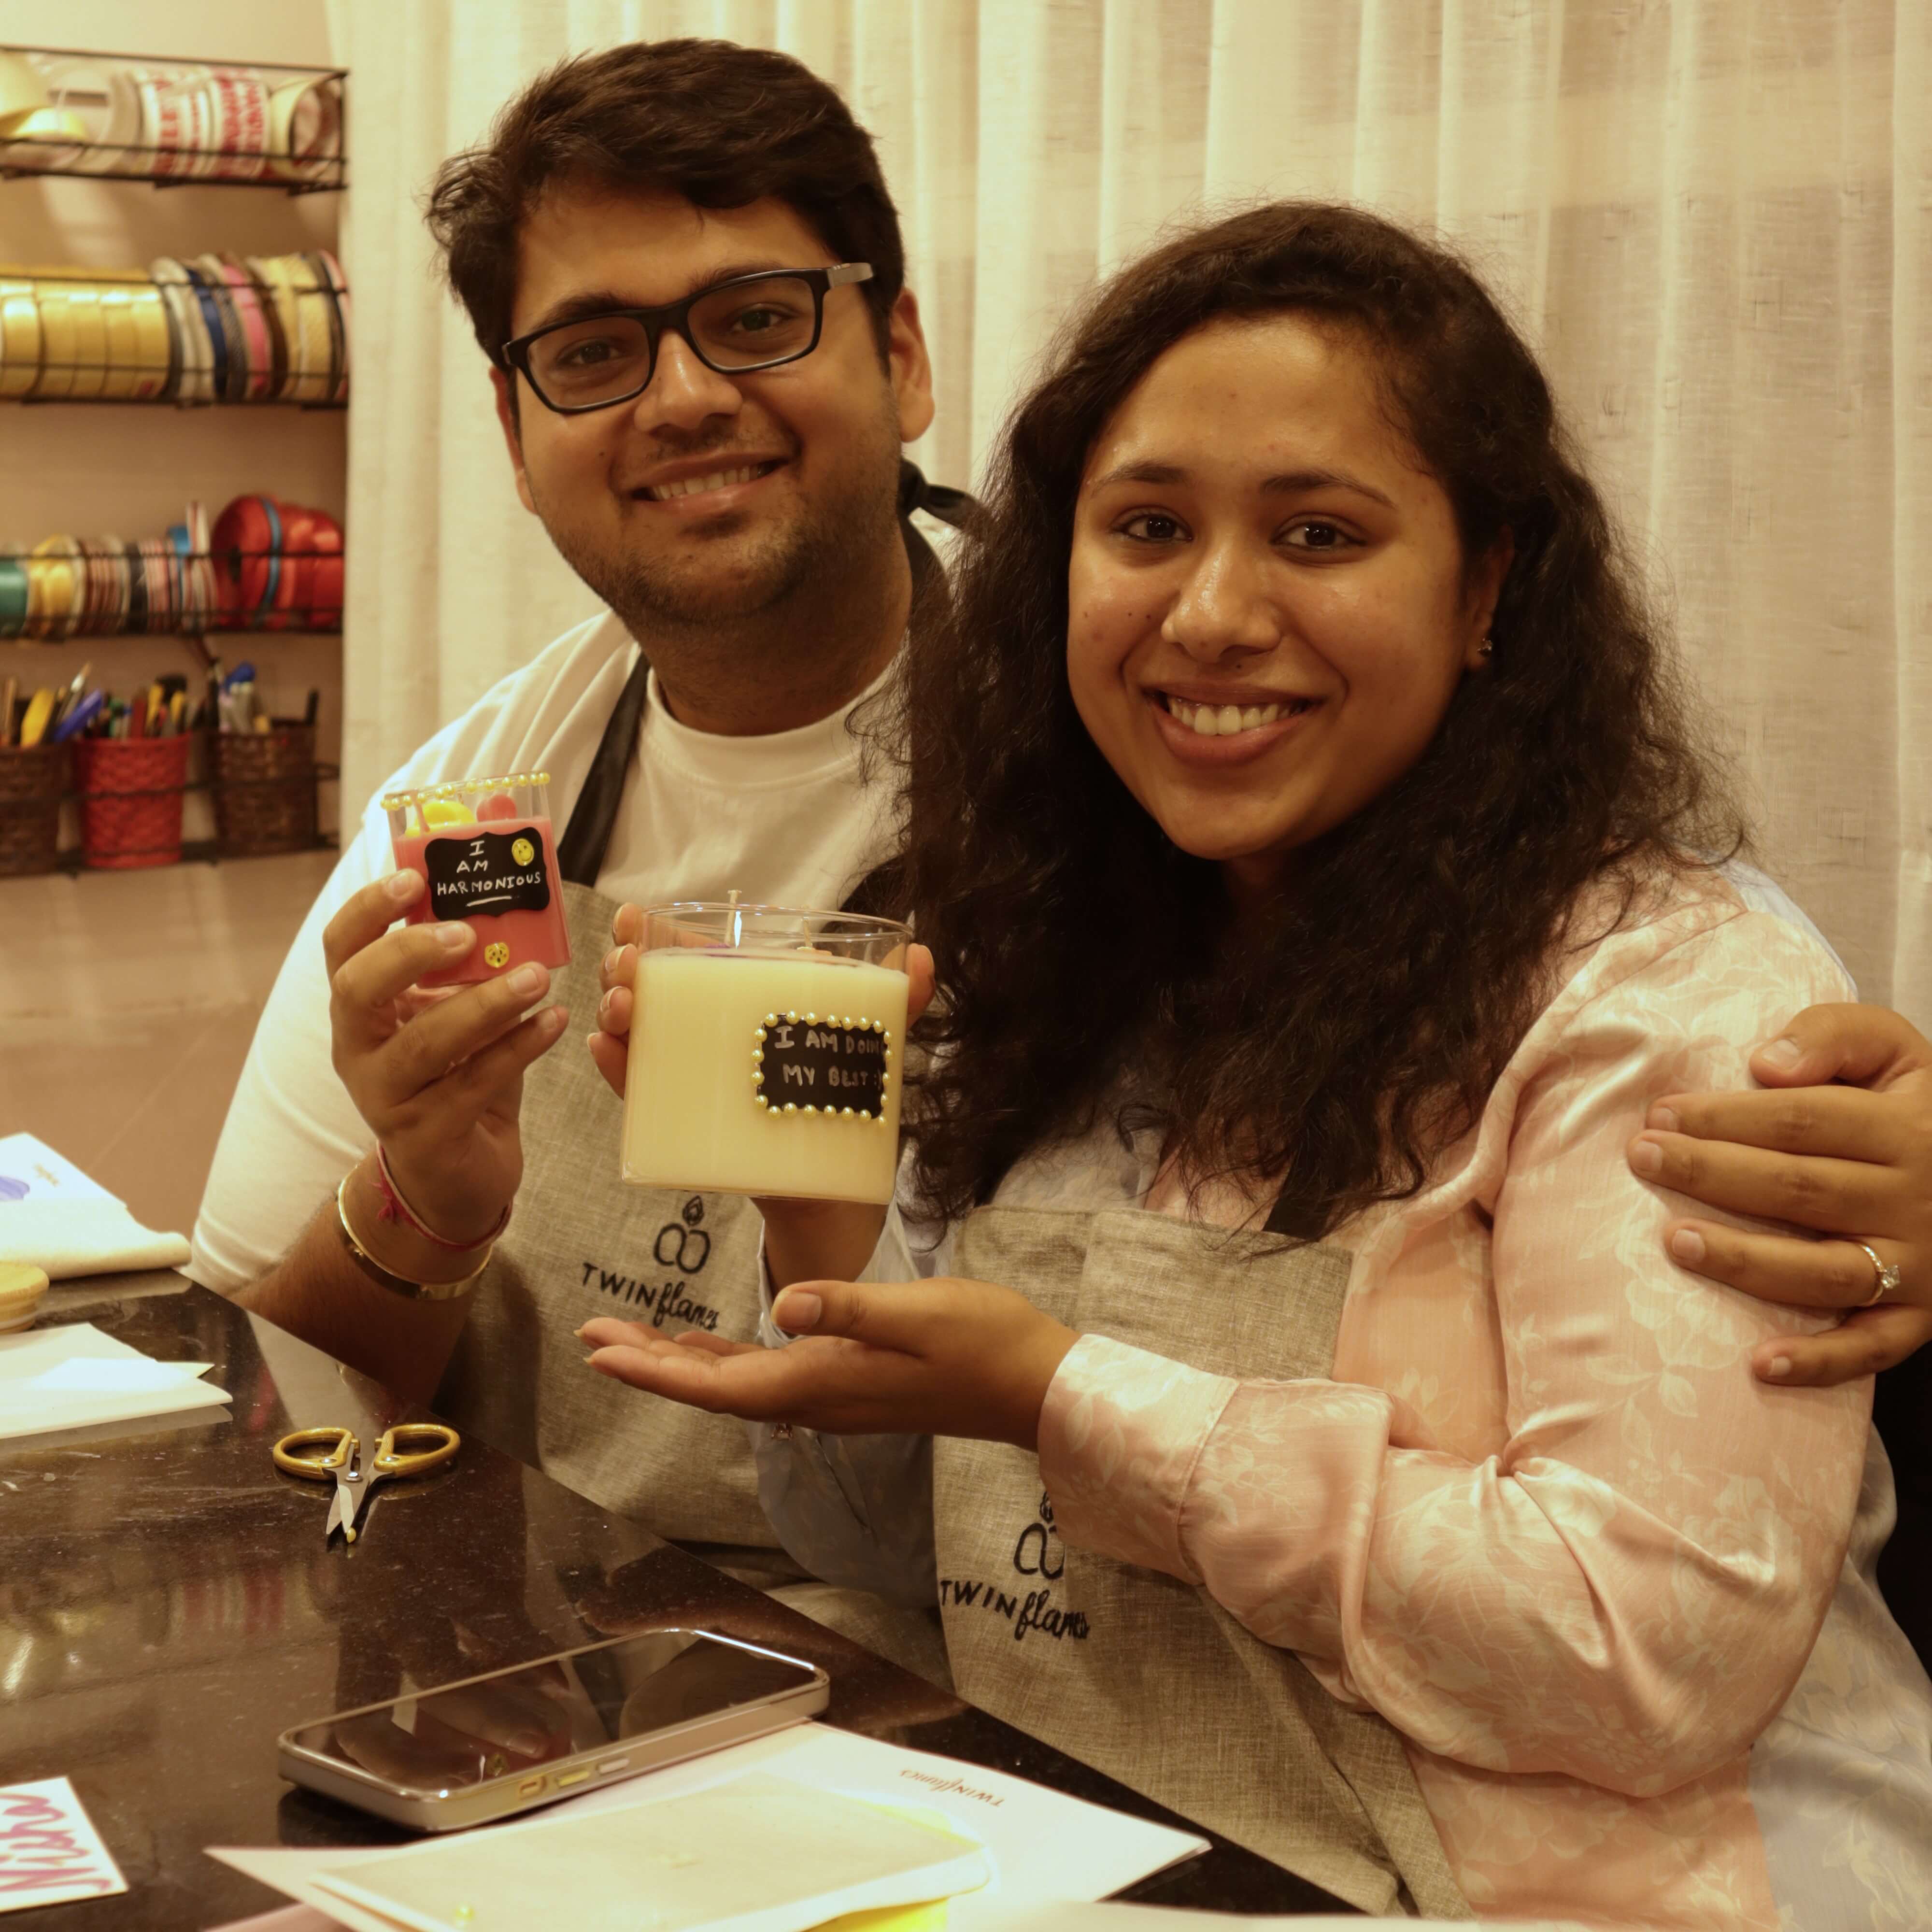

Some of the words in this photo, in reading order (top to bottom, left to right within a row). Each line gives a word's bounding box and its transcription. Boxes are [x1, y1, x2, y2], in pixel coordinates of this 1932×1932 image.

[469, 840, 485, 856] I
[456, 860, 488, 873] AM
[437, 871, 541, 896] HARMONIOUS
[774, 1025, 795, 1049] I
[805, 1030, 838, 1052] AM
[782, 1064, 815, 1086] MY
